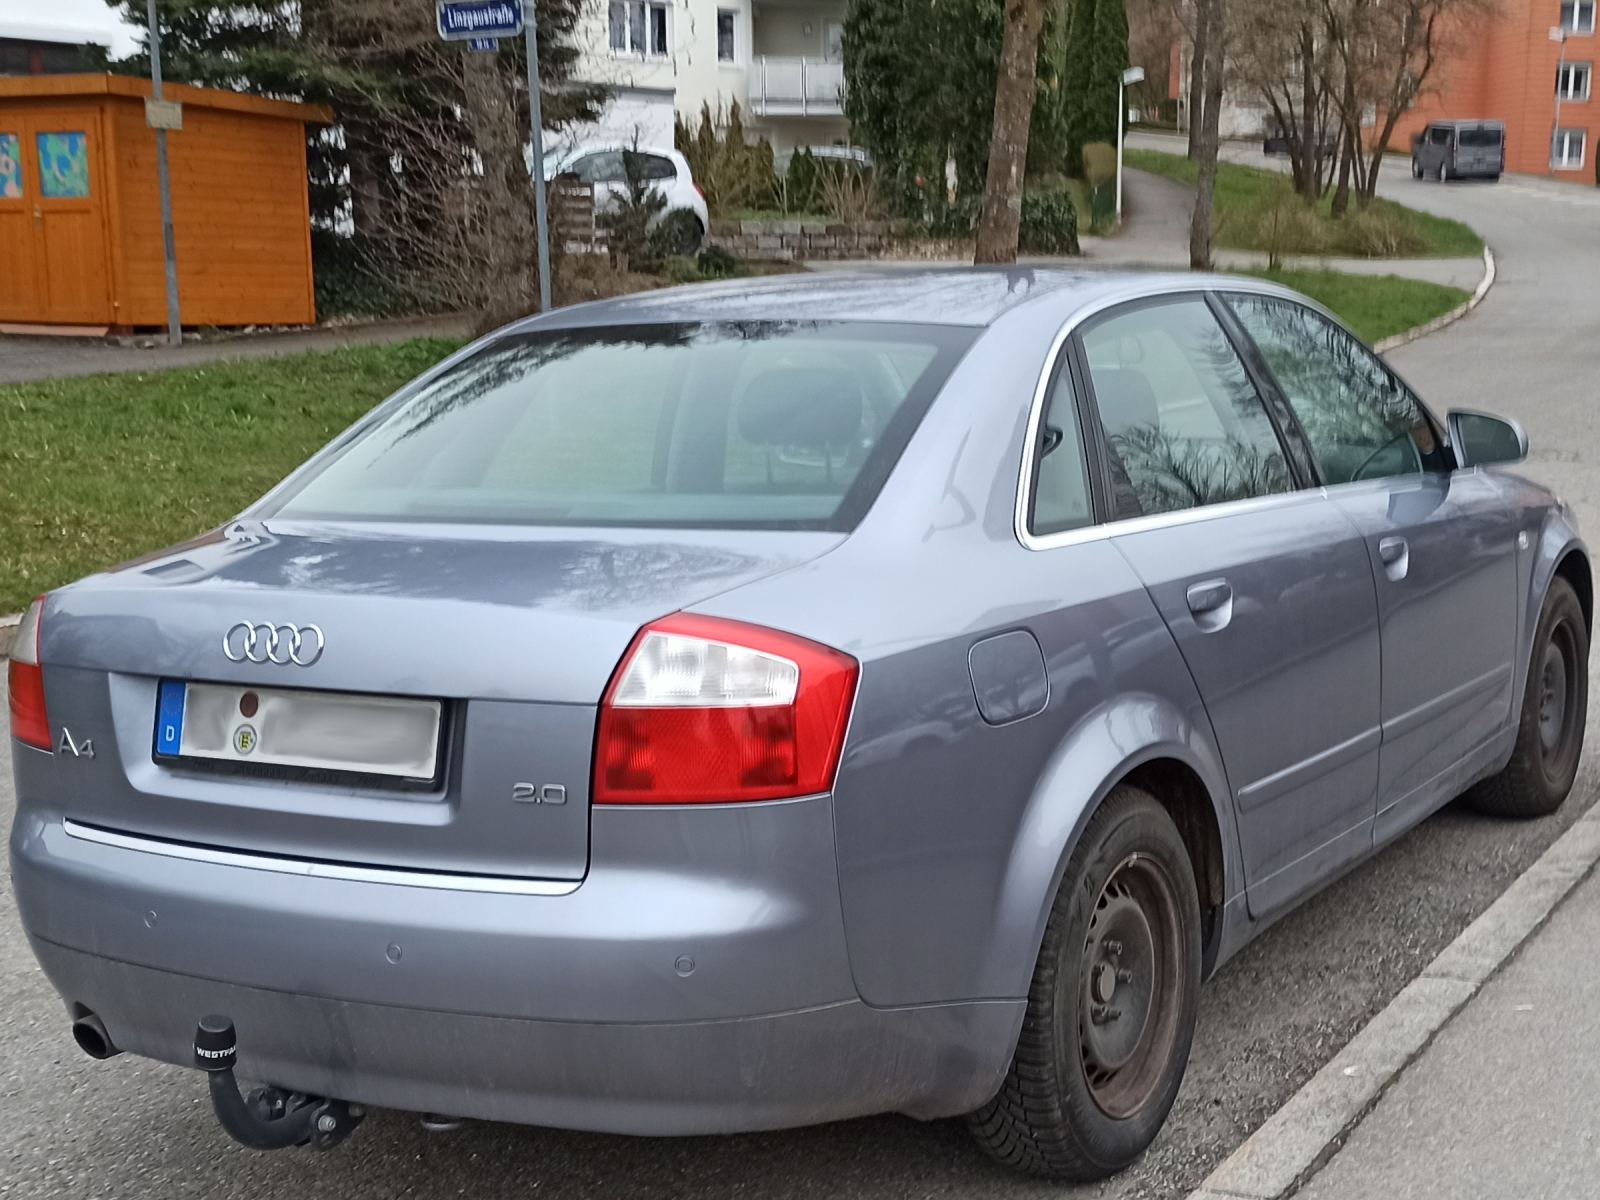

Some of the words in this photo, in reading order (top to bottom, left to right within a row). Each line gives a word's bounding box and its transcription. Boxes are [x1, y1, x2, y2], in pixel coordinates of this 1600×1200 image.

[59, 727, 95, 759] A4
[165, 725, 175, 742] D
[512, 781, 567, 806] 2.0
